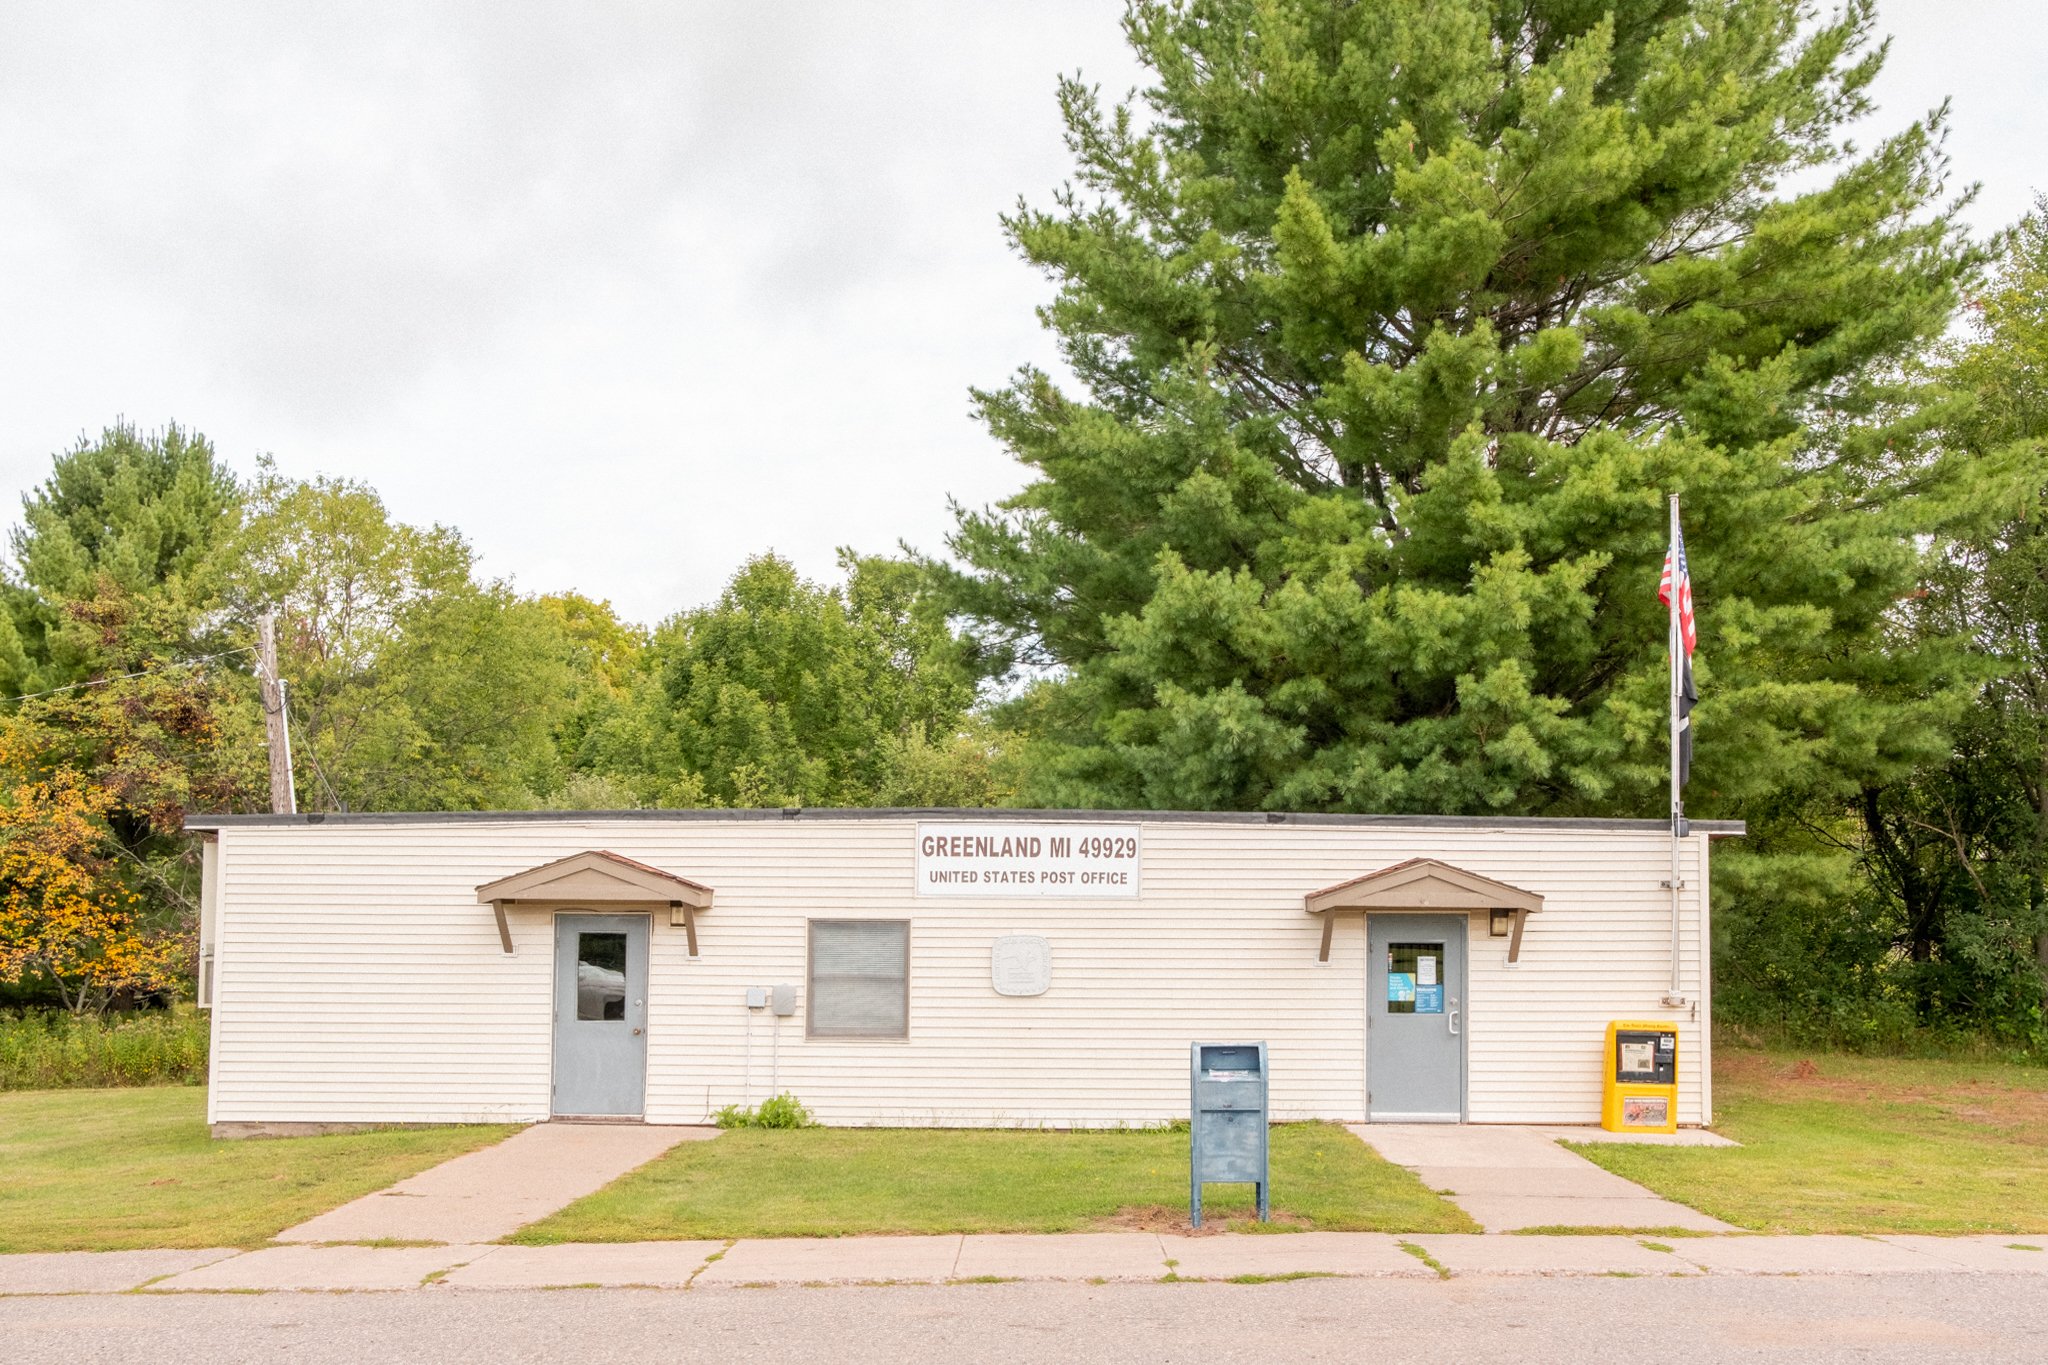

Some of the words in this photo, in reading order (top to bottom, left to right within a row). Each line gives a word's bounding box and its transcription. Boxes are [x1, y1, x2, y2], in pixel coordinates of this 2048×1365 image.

[922, 835, 1041, 858] GREENLAND
[1050, 837, 1071, 858] MI
[1078, 837, 1137, 859] 49929
[929, 870, 978, 883] UNITED
[983, 870, 1035, 883] STATES
[1041, 871, 1076, 884] POST
[1080, 872, 1128, 885] OFFICE
